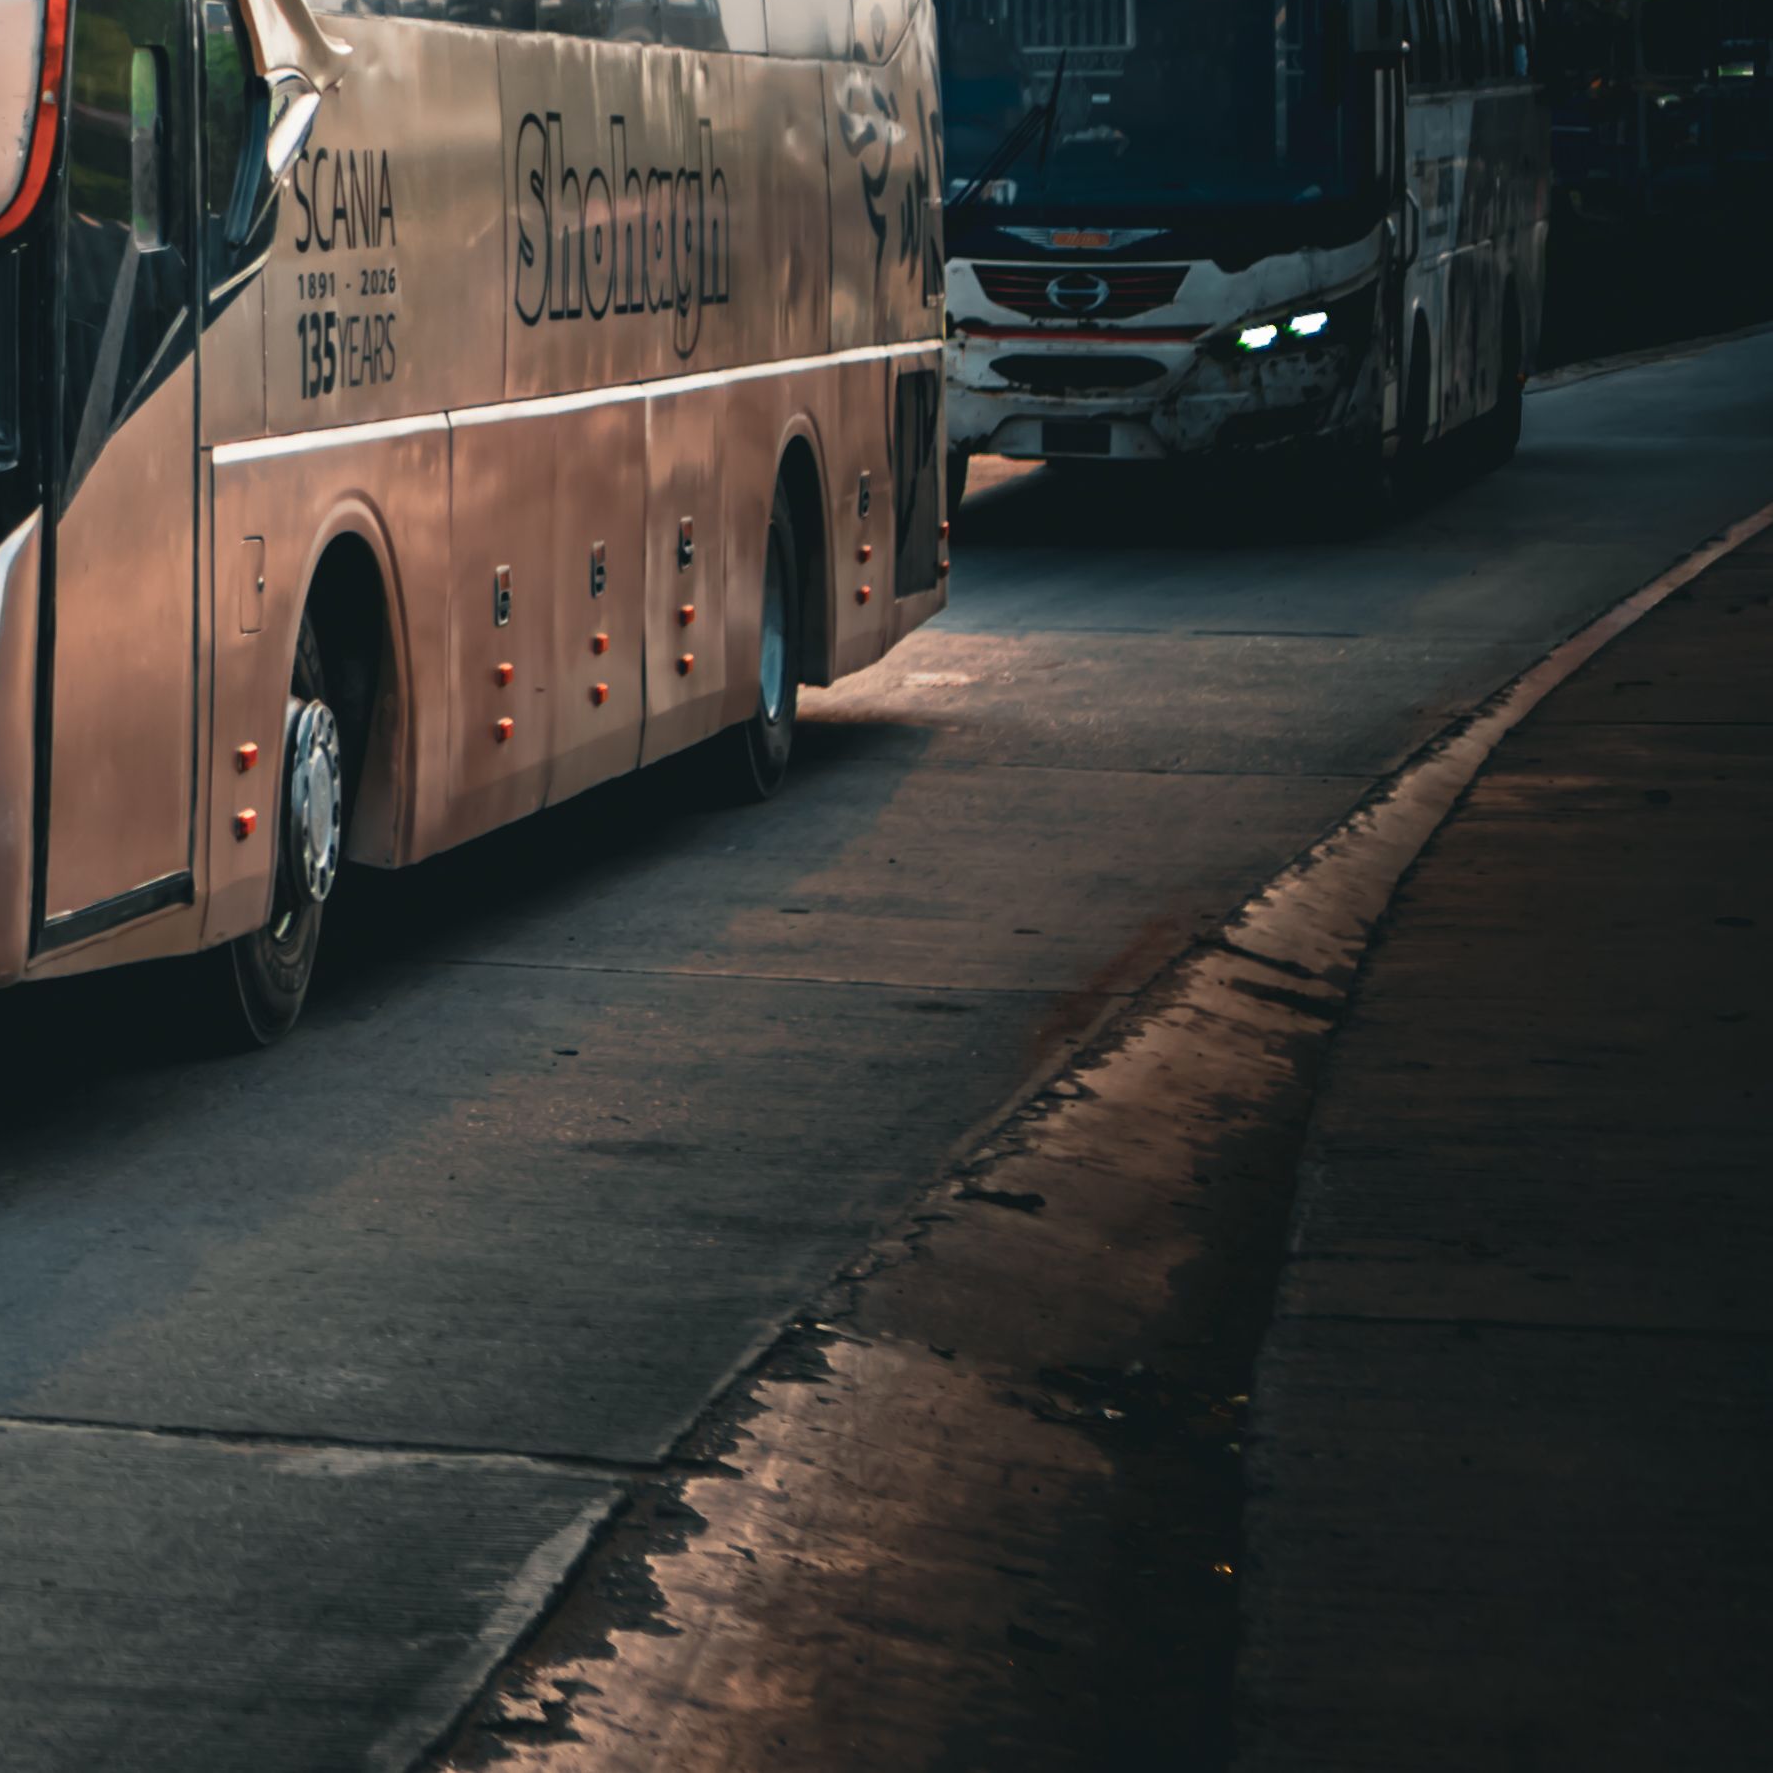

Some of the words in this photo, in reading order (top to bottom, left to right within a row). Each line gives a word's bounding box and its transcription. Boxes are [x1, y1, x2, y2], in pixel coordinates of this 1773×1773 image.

[294, 147, 396, 253] SCANIA
[515, 112, 730, 360] Shohagh
[298, 272, 336, 300] 1891
[360, 268, 396, 296] 2026
